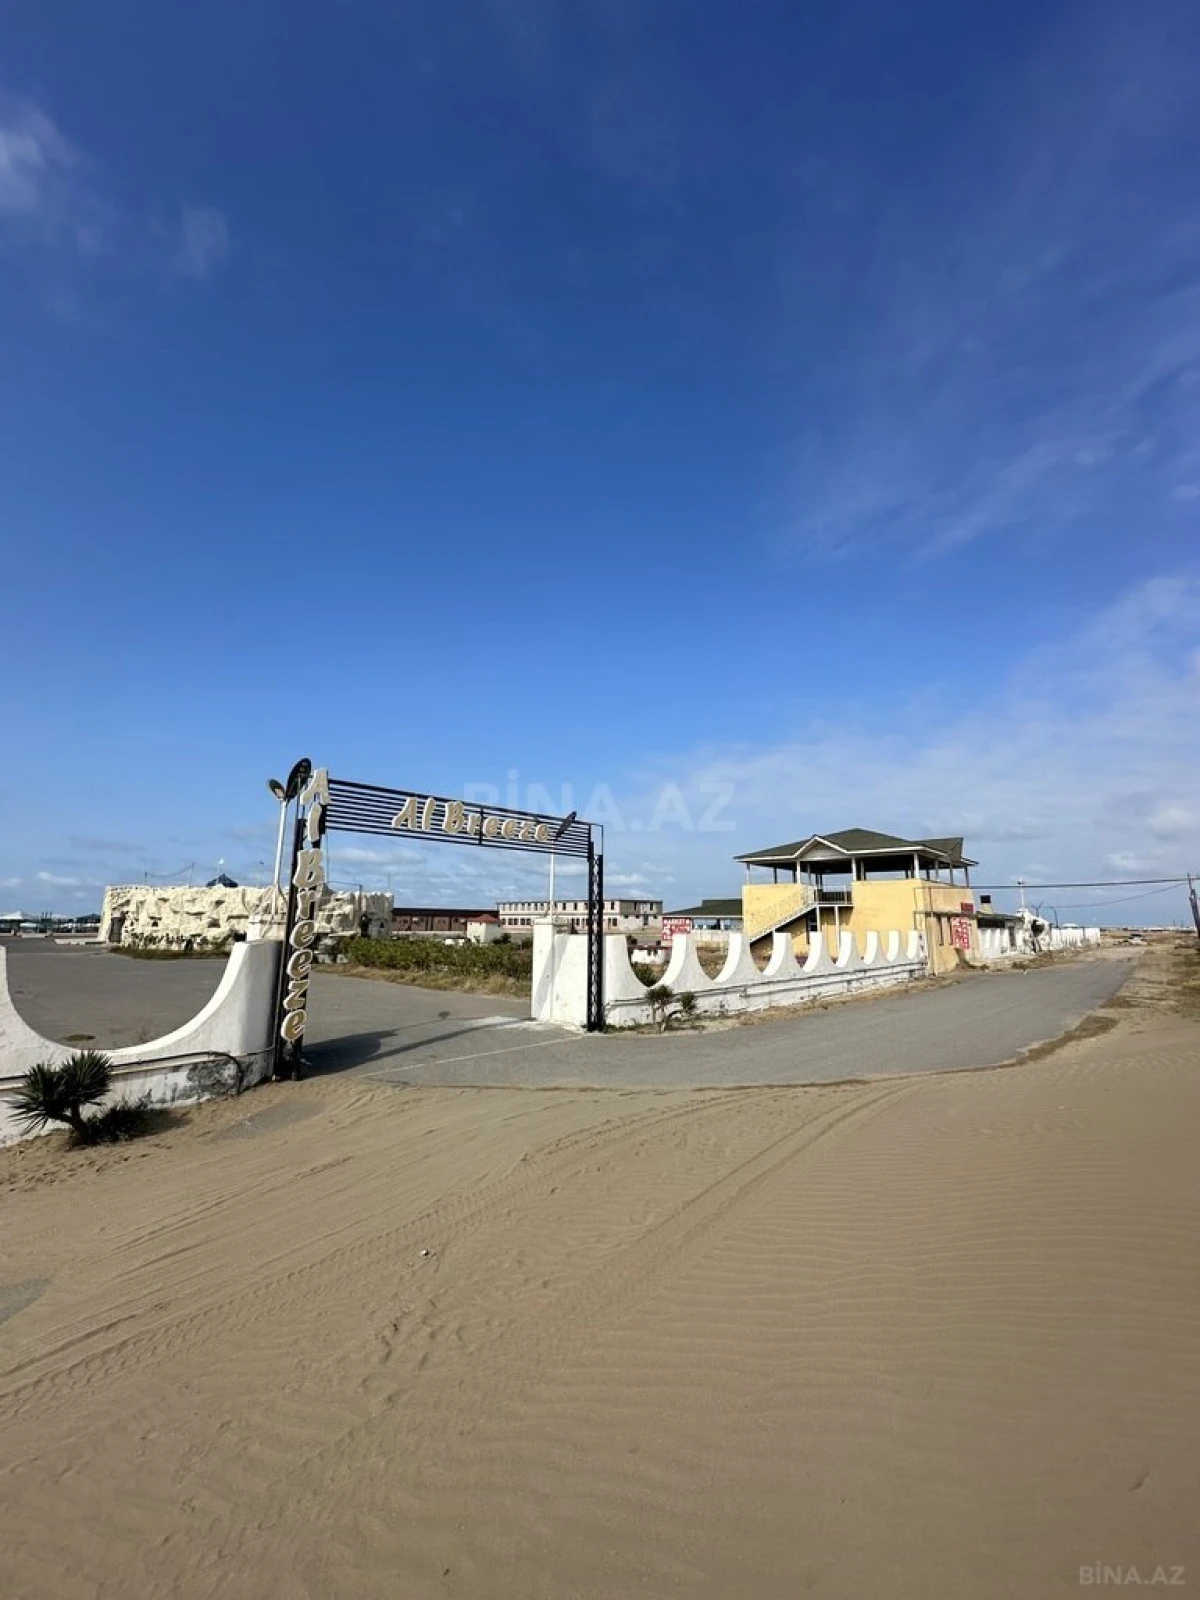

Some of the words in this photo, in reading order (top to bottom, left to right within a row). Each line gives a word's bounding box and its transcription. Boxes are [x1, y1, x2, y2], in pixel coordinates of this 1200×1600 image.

[392, 797, 436, 831] Al
[442, 800, 549, 841] Breeze
[281, 849, 325, 1041] Breeze
